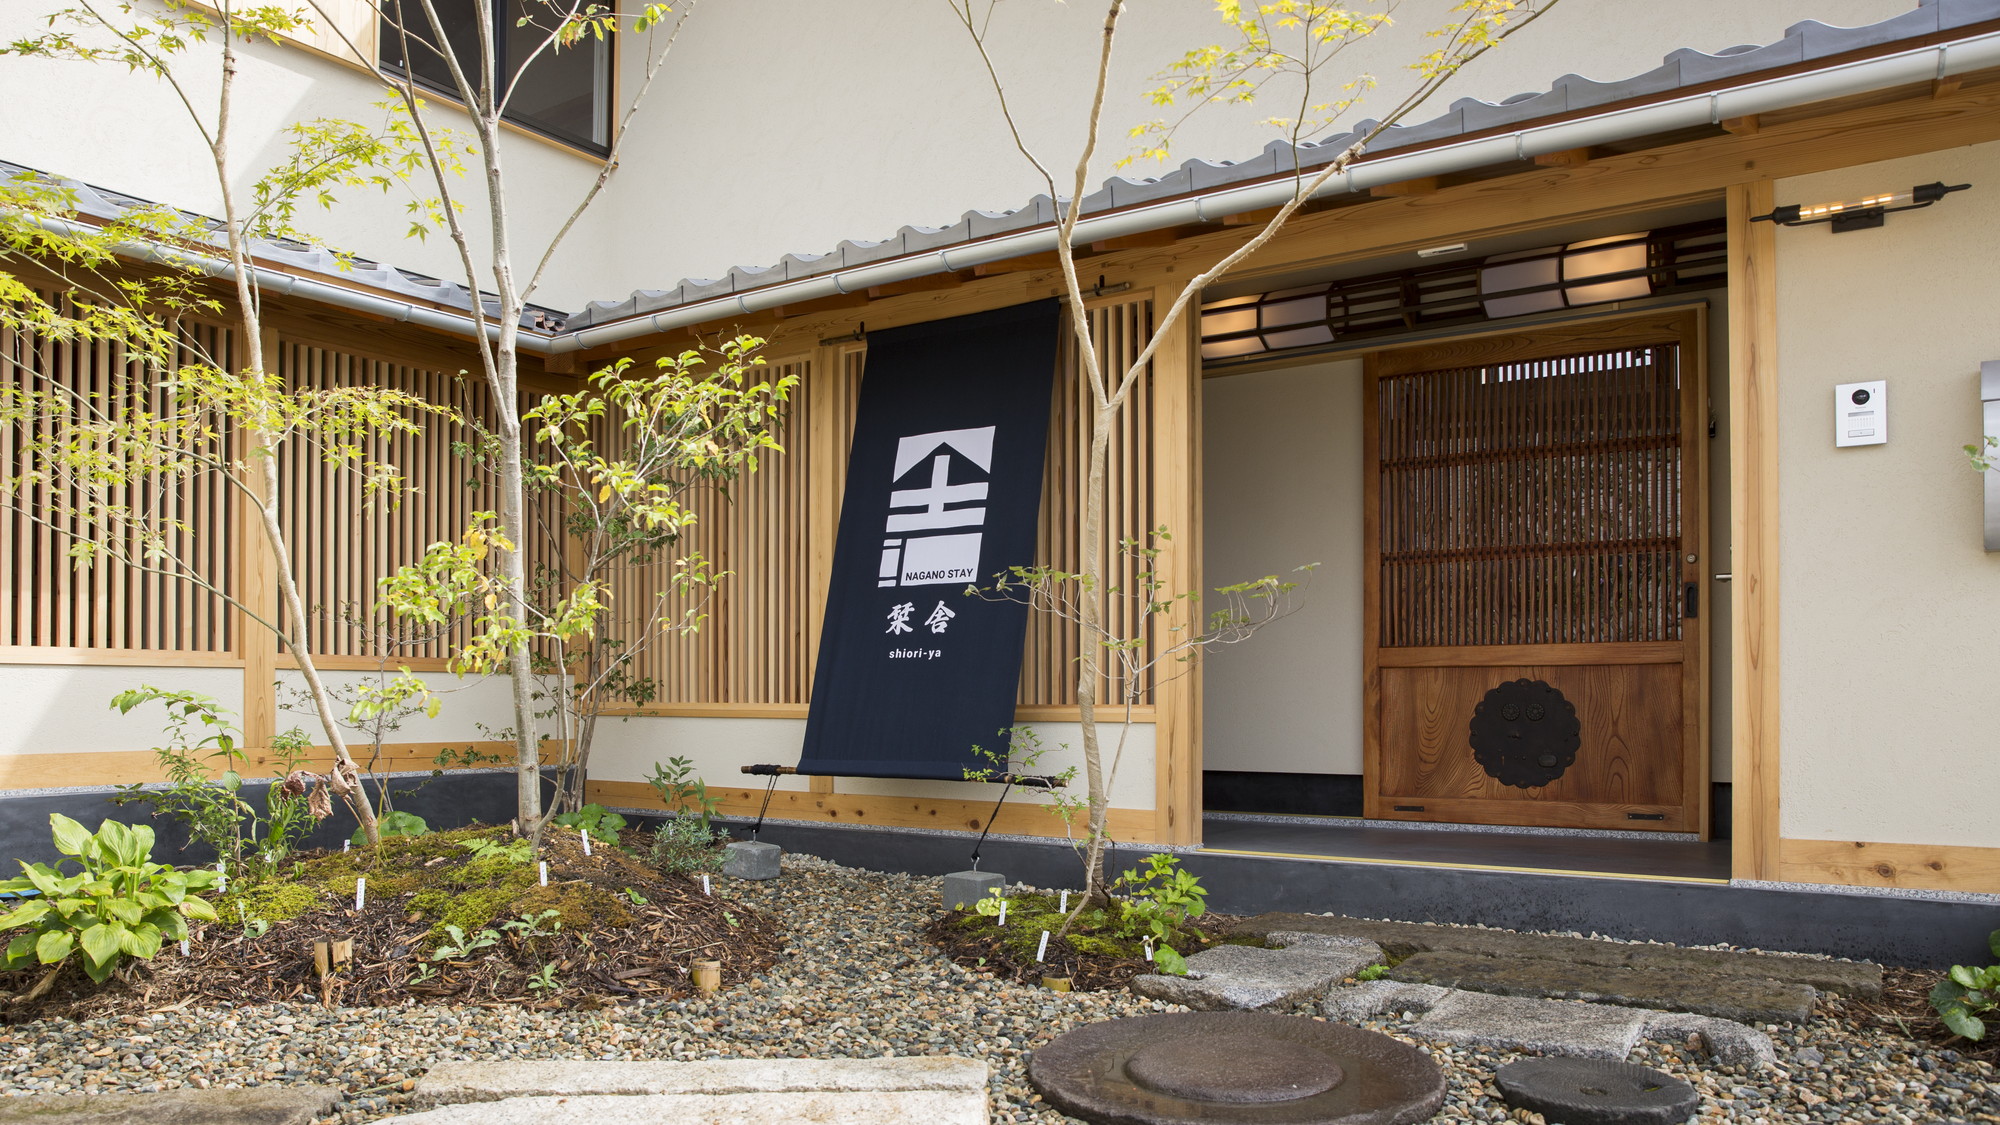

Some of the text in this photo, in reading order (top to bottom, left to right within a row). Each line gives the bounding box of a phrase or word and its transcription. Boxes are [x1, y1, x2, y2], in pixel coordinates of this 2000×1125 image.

[905, 568, 974, 581] NAGANO STAY
[888, 648, 942, 660] shiori-ya
